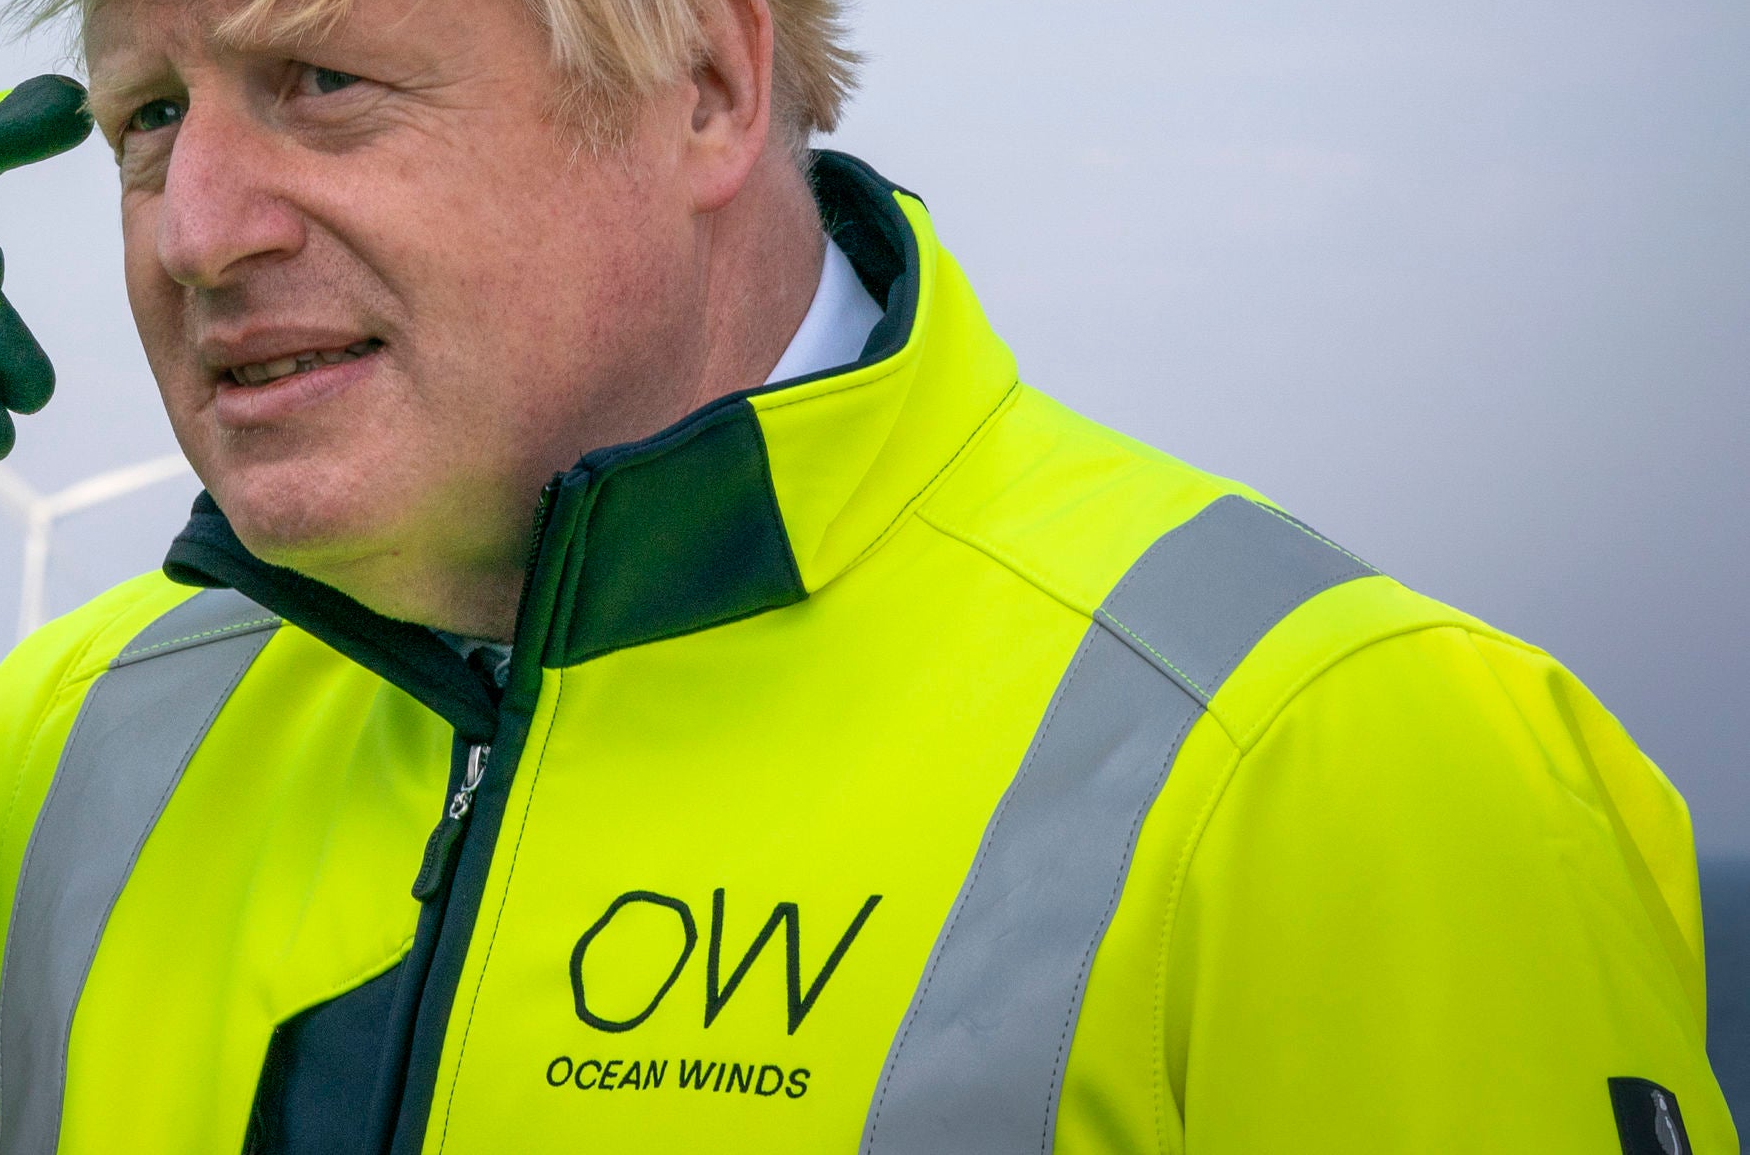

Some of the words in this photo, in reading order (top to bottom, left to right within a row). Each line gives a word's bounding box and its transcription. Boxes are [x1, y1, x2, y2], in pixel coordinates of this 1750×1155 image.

[568, 887, 884, 1036] OW
[545, 1055, 669, 1092] OCEAN
[678, 1058, 812, 1100] WINDS
